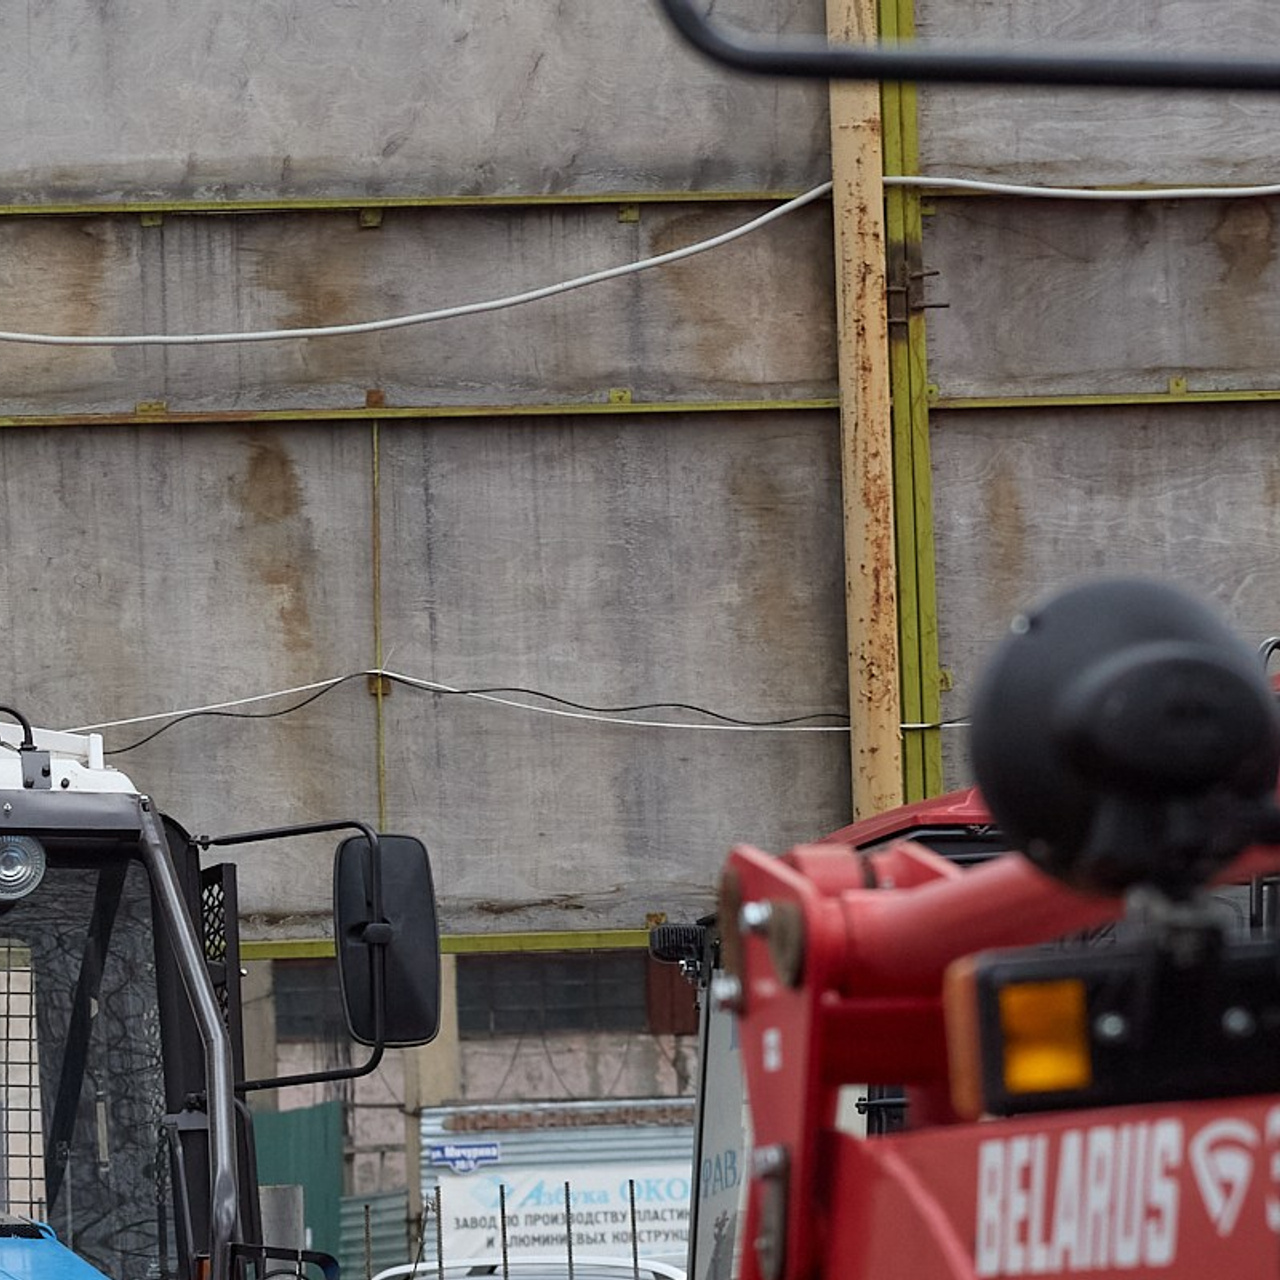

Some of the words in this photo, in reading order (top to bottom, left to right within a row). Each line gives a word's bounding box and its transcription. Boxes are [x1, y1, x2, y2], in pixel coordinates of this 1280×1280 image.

[619, 1177, 690, 1204] ОКО
[975, 1117, 1183, 1278] BELARUS
[454, 1215, 498, 1230] ЗАВОД
[635, 1207, 690, 1223] ПЛАСТИ
[506, 1231, 606, 1248] ЛЮМИНИВЫХ
[612, 1230, 690, 1245] КОСТРУКЦ
